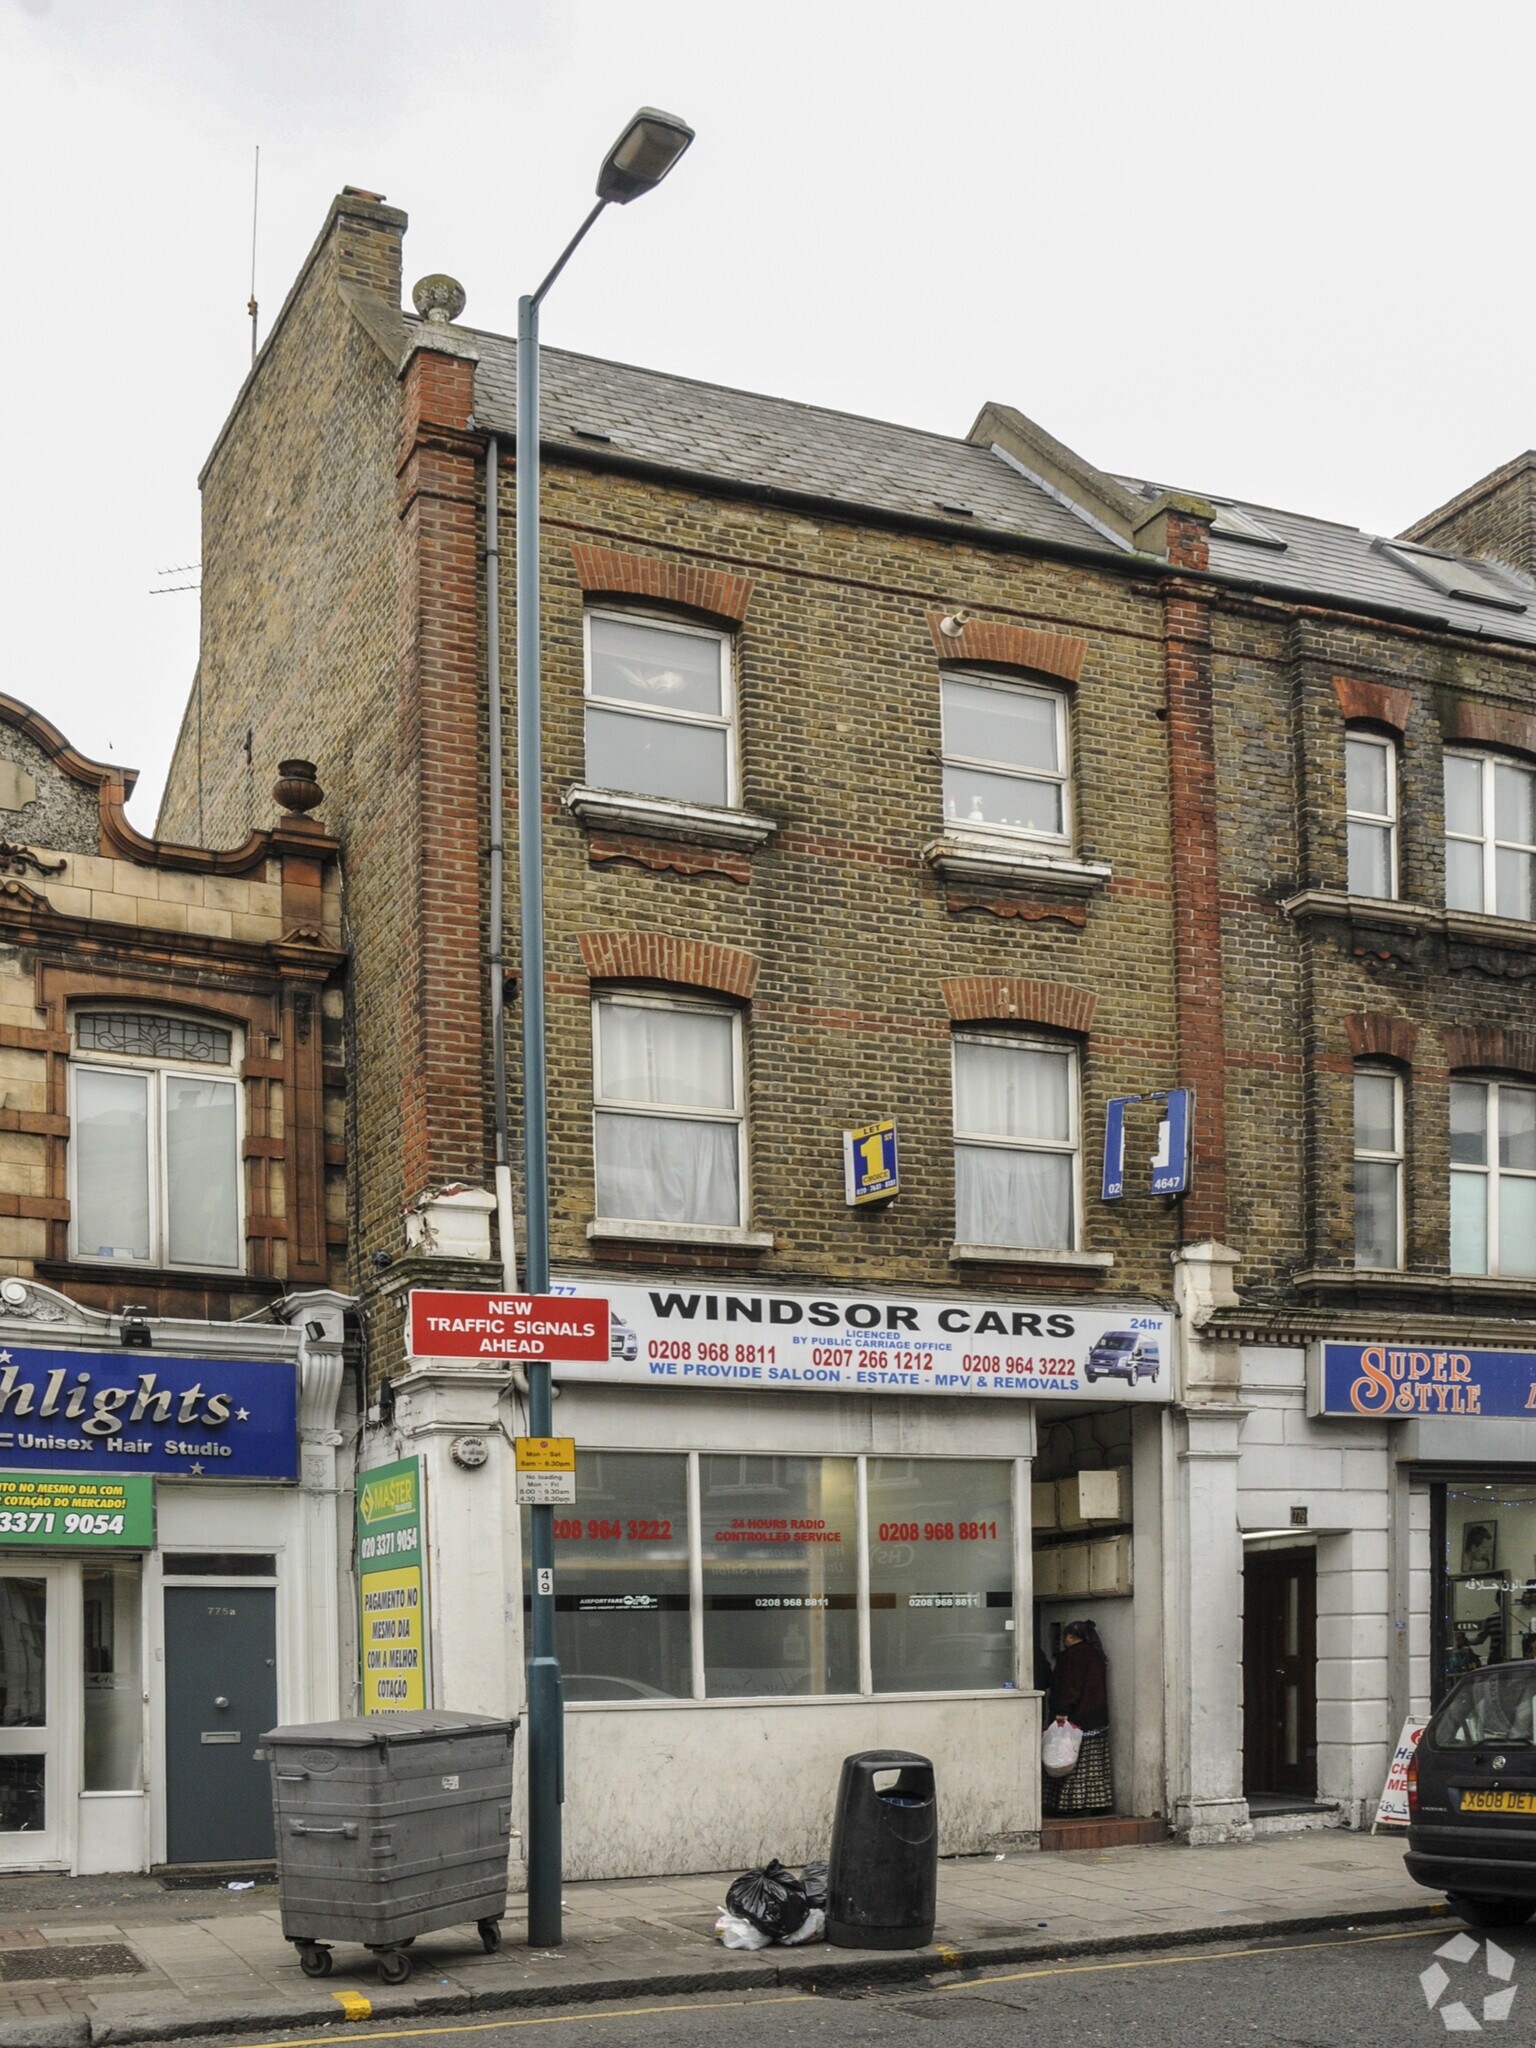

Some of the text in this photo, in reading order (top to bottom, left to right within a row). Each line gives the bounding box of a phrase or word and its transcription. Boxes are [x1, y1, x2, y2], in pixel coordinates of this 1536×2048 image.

[864, 1124, 880, 1134] LET
[1108, 1177, 1180, 1194] 02 4647
[488, 1300, 533, 1315] NEW
[648, 1291, 1076, 1339] WINDSOR CARS
[426, 1317, 596, 1337] TRAFFIC SIGNALS
[1130, 1317, 1164, 1330] 24hr
[792, 1336, 953, 1352] BY PUBLIC CARRIAGE OFFICE
[846, 1330, 901, 1341] LICENCED
[479, 1338, 545, 1354] AHEAD
[648, 1340, 776, 1364] 0208 968 8811
[812, 1347, 933, 1371] 0207 266 1212
[962, 1354, 1076, 1377] 0208 964 3222
[649, 1362, 677, 1375] WE
[683, 1363, 762, 1379] PROVIDE
[768, 1367, 841, 1382] SALOON
[857, 1371, 920, 1385] ESTATE
[935, 1374, 971, 1387] MPV
[976, 1376, 988, 1387] &
[993, 1377, 1079, 1391] REMOVALS
[1350, 1347, 1472, 1415] SUPER
[1395, 1382, 1481, 1415] STYLE
[18, 1433, 233, 1457] Unisex Hair Studio
[19, 1483, 35, 1493] NO
[37, 1484, 77, 1494] MESMO
[79, 1485, 97, 1495] DIA
[99, 1486, 123, 1496] COM
[4, 1495, 126, 1509] COTAÇÃO DO MERCADO!
[0, 1511, 125, 1535] 3371 9054
[588, 1519, 622, 1540] 964
[627, 1519, 673, 1540] 3222
[731, 1519, 825, 1530] 24 HOURS RADIO
[879, 1521, 997, 1542] 0208 968 8811
[362, 1527, 417, 1559] 020 3371 9054
[715, 1531, 842, 1542] CONTROLLED SERVICE
[541, 1571, 549, 1580] 4
[541, 1583, 550, 1593] 9
[364, 1586, 418, 1612] PAGAMENTO NO
[755, 1598, 829, 1607] 0208 968 8811
[908, 1597, 978, 1607] 0208 968 8811
[371, 1618, 411, 1640] MESMO DIA
[367, 1648, 418, 1669] COM A MELHOR
[377, 1673, 407, 1704] COTAÇÃO
[1467, 1791, 1503, 1808] X608
